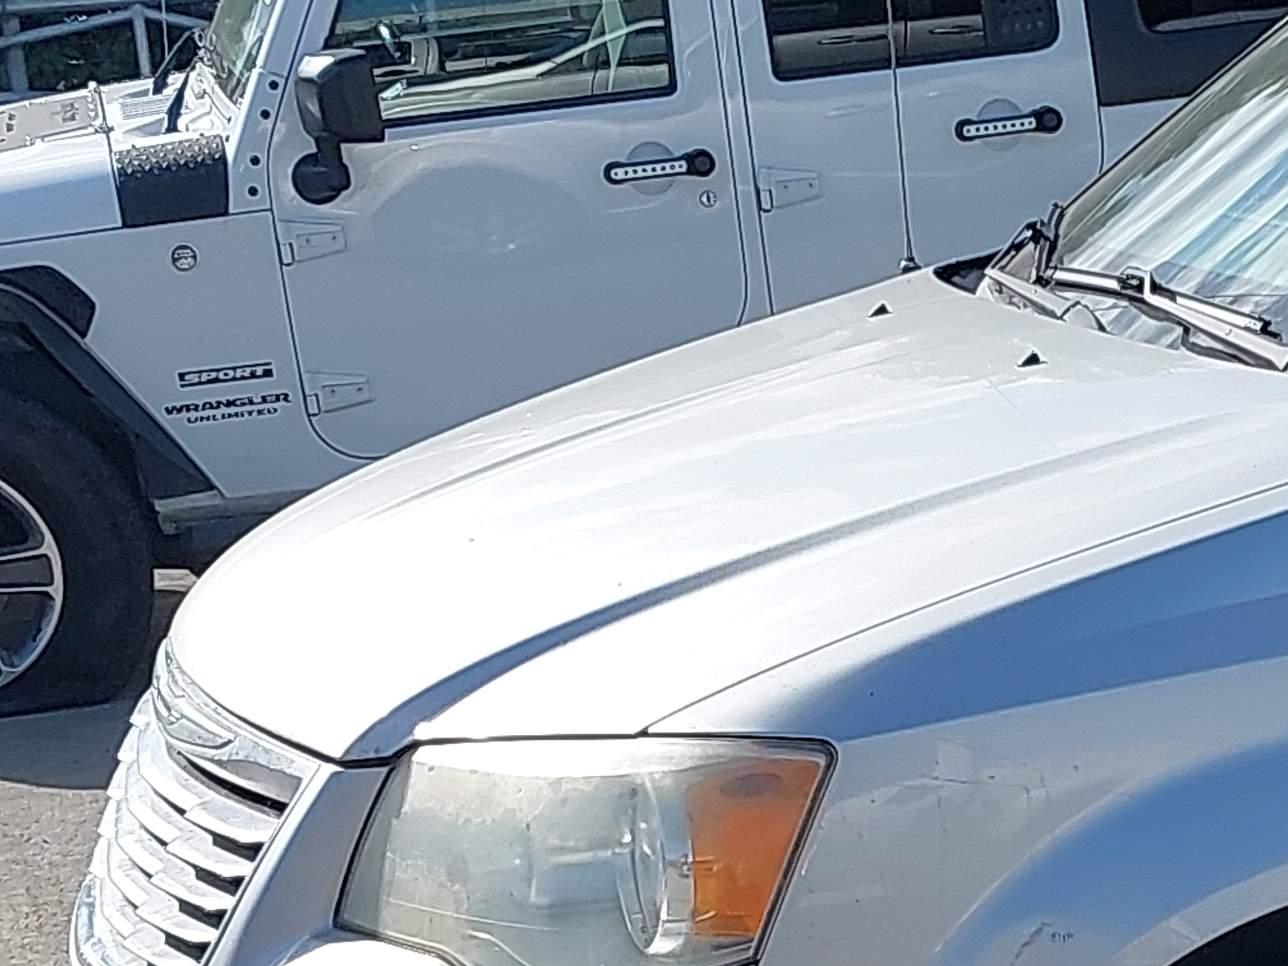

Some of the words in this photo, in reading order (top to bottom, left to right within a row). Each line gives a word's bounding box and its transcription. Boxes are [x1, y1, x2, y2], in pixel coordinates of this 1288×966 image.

[182, 366, 268, 385] SPORT
[164, 392, 292, 416] WRANGLER
[186, 406, 279, 425] UNLIMITED
